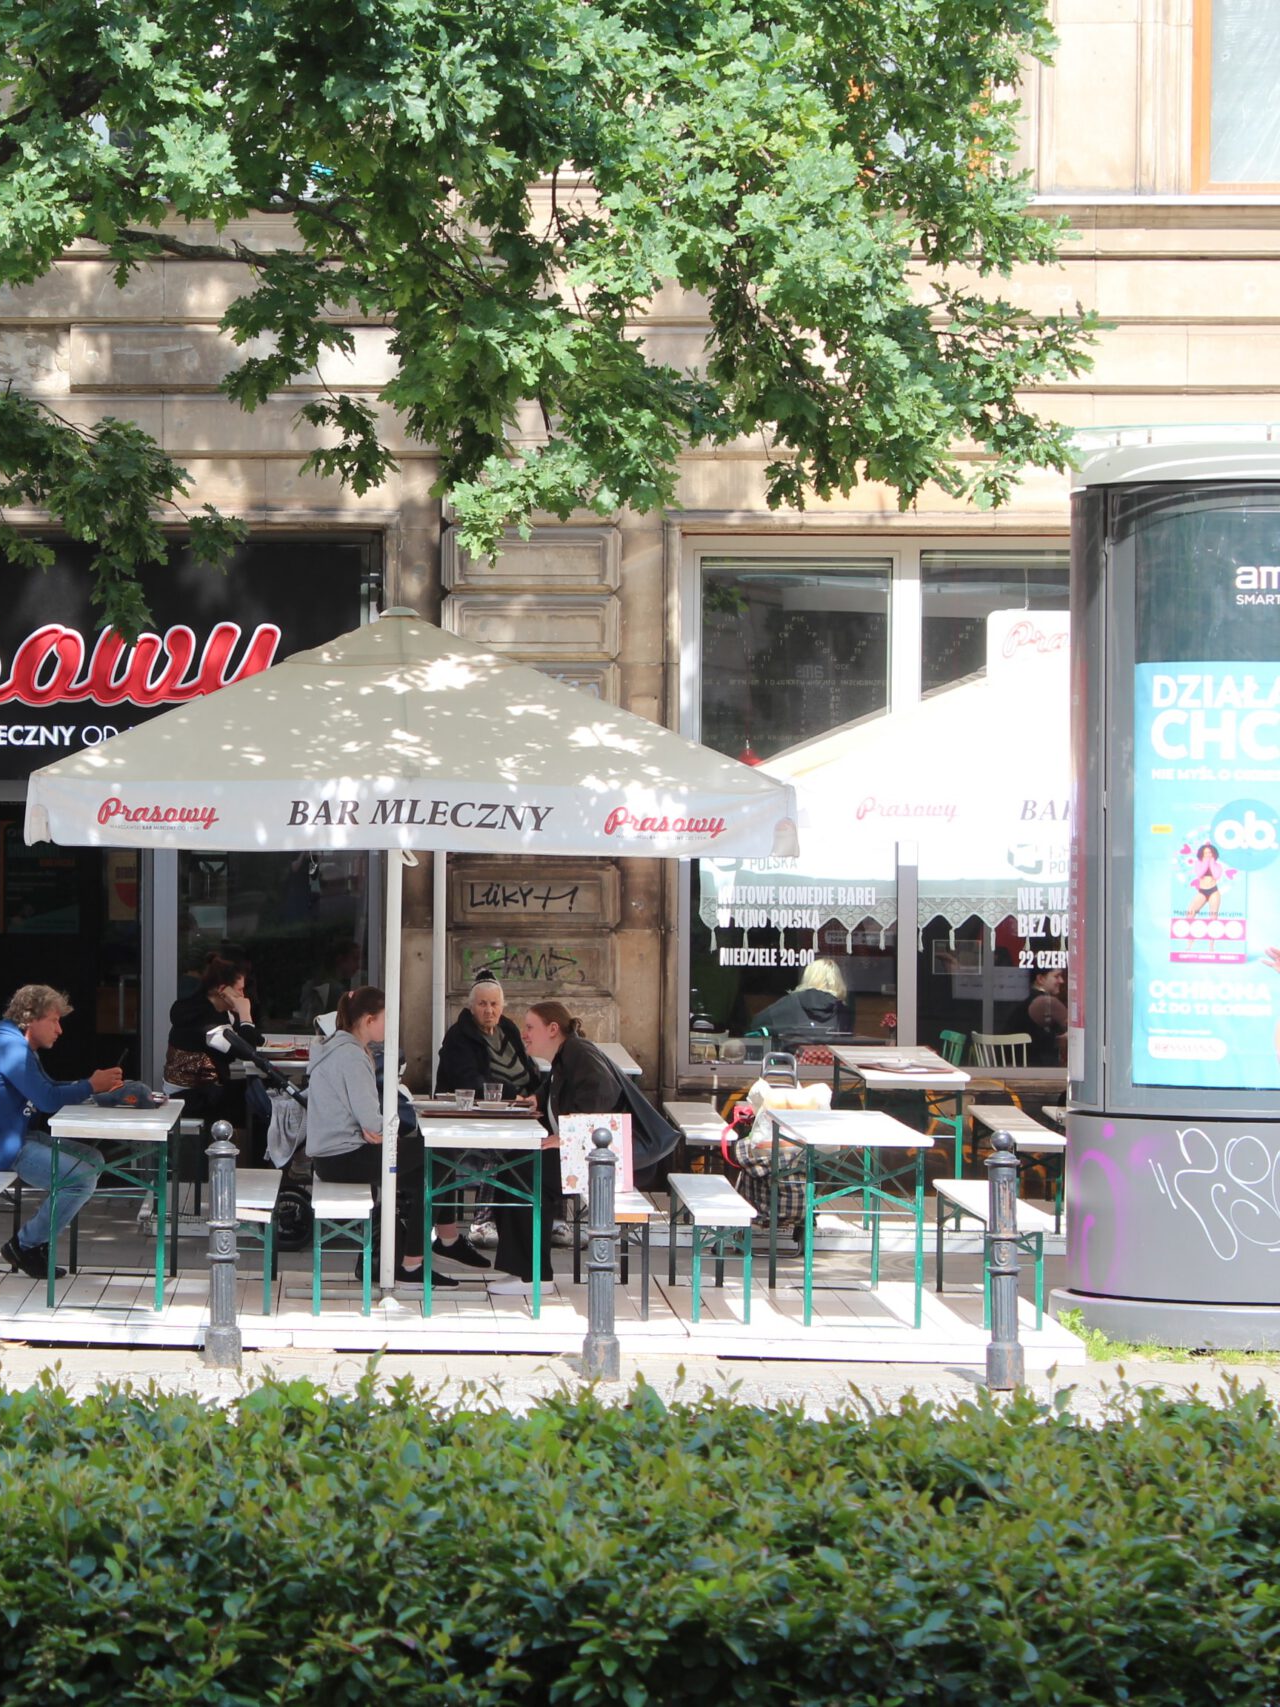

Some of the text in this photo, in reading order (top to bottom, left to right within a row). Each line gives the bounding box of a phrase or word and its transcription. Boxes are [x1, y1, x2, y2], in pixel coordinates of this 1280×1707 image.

[1151, 709, 1280, 761] CHC
[96, 796, 220, 830] Prasowy
[287, 799, 555, 832] BAR MLECZNY
[856, 796, 960, 823] Prasowy
[603, 806, 728, 839] Prasowy
[778, 886, 834, 905] KOMEDIE
[838, 886, 876, 906] BAREI
[1017, 887, 1044, 910] NIE
[719, 909, 820, 929] W KINO POLSKA
[1017, 914, 1046, 938] BEZ
[720, 948, 815, 967] NIEDZIELE 20:00
[1018, 951, 1034, 968] 22
[1148, 979, 1272, 1001] OCHRONA
